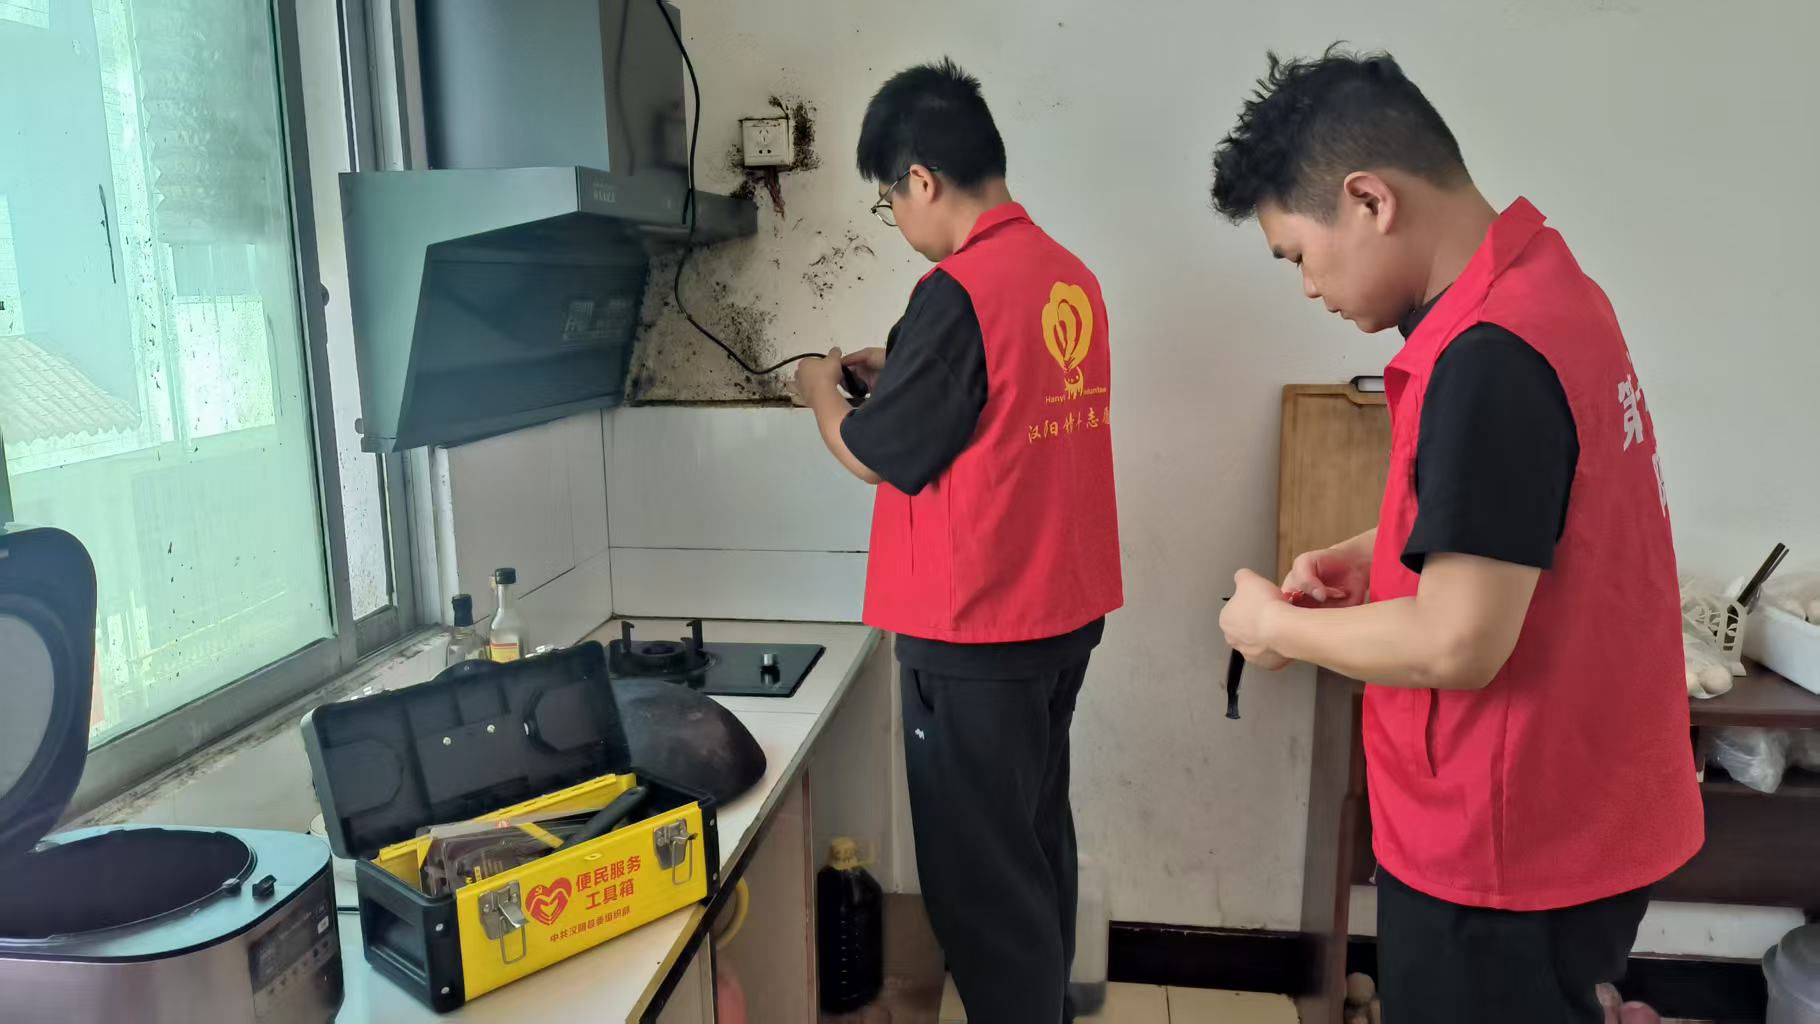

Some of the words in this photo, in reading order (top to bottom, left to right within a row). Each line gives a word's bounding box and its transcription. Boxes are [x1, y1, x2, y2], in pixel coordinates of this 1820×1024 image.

[576, 855, 641, 892] 便民服务
[586, 879, 635, 910] 工具箱
